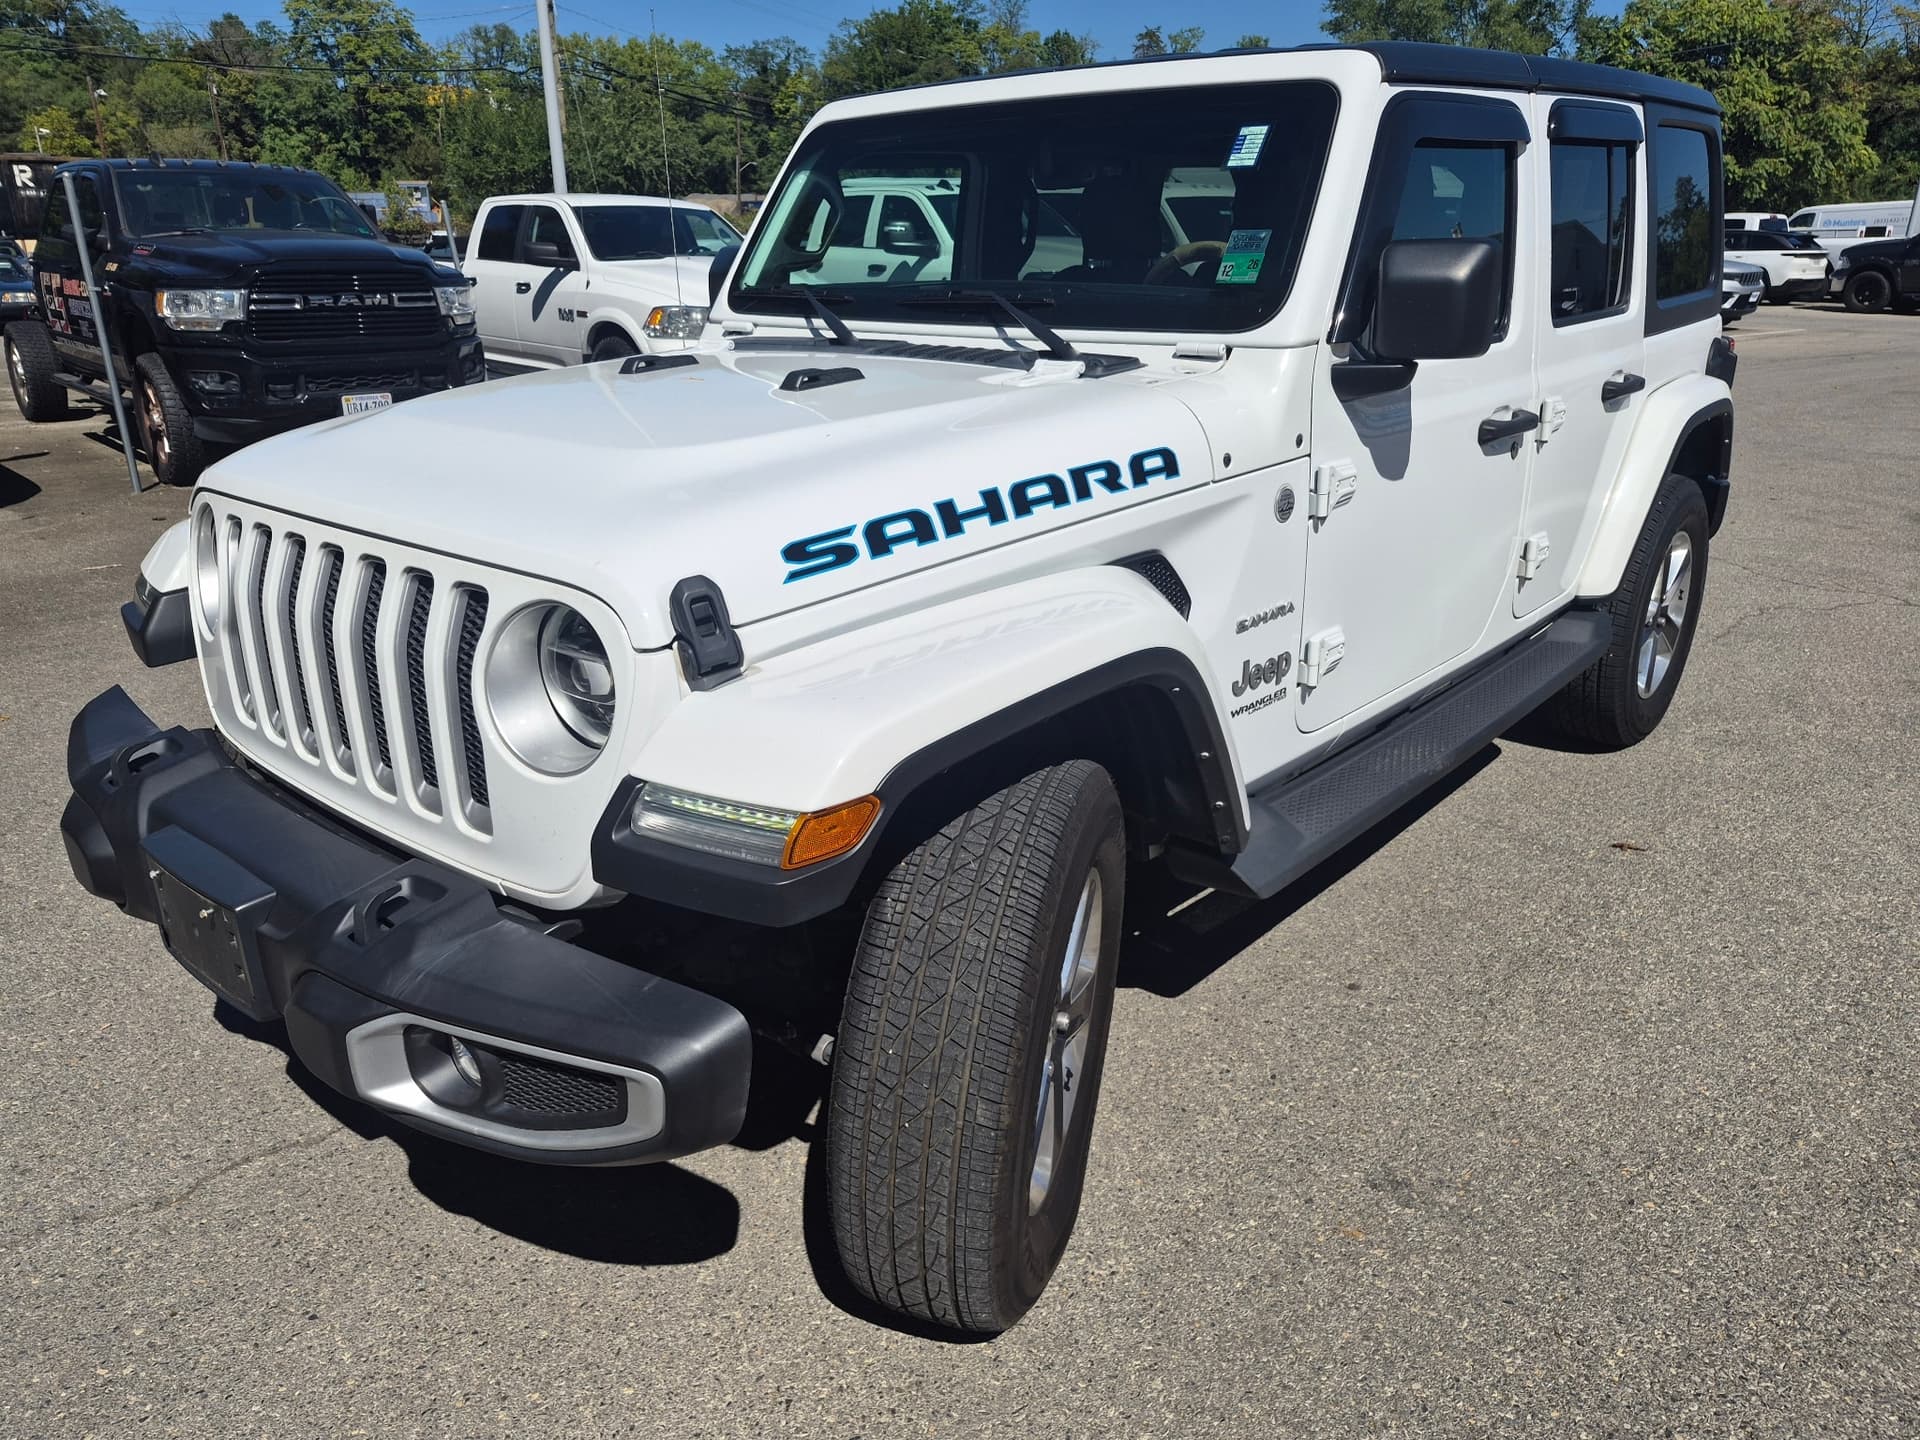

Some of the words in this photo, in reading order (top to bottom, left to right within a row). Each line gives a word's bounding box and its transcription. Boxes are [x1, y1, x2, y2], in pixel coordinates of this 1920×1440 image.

[0, 164, 36, 187] R
[1222, 264, 1234, 278] 12
[308, 294, 389, 307] RAM
[779, 446, 1181, 585] SAHARA
[1236, 601, 1295, 635] SAHARA
[1231, 651, 1292, 698] Jeep
[1230, 687, 1287, 719] WRANGLER
